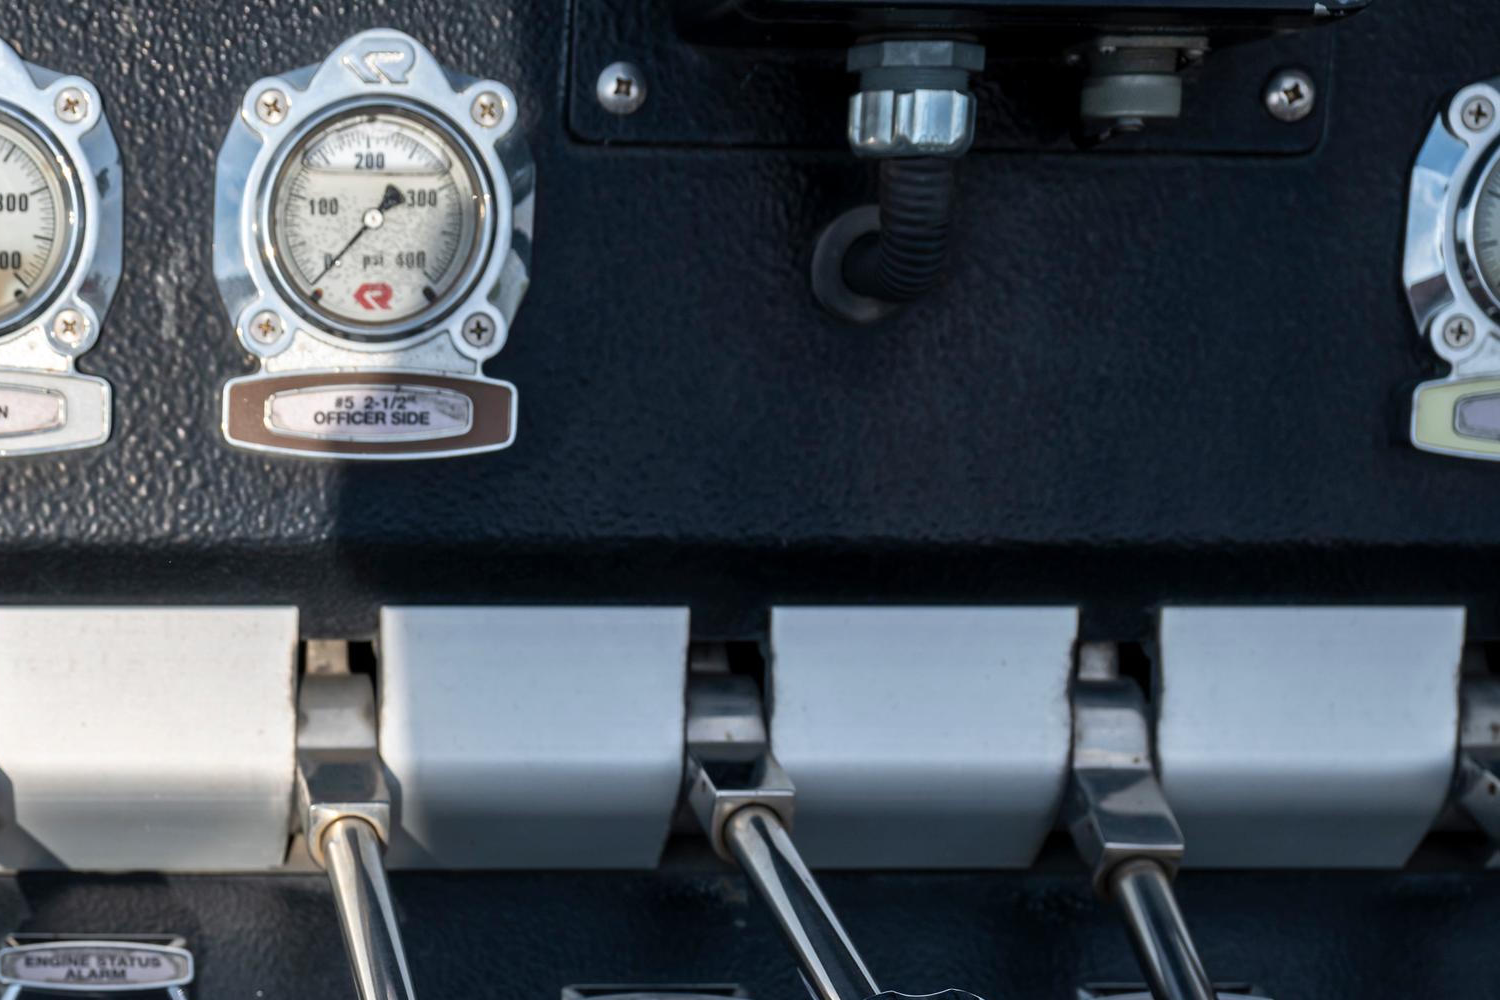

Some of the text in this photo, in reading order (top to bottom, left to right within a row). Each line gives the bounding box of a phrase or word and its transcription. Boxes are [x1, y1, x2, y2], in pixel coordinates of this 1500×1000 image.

[355, 153, 385, 170] 200
[309, 197, 338, 215] 100
[407, 189, 437, 207] 300
[362, 252, 384, 269] psi
[334, 396, 354, 410] #5
[314, 411, 430, 426] OFFICER SIDE
[24, 955, 162, 968] ENGINE STATUS
[65, 968, 127, 980] ALARM
